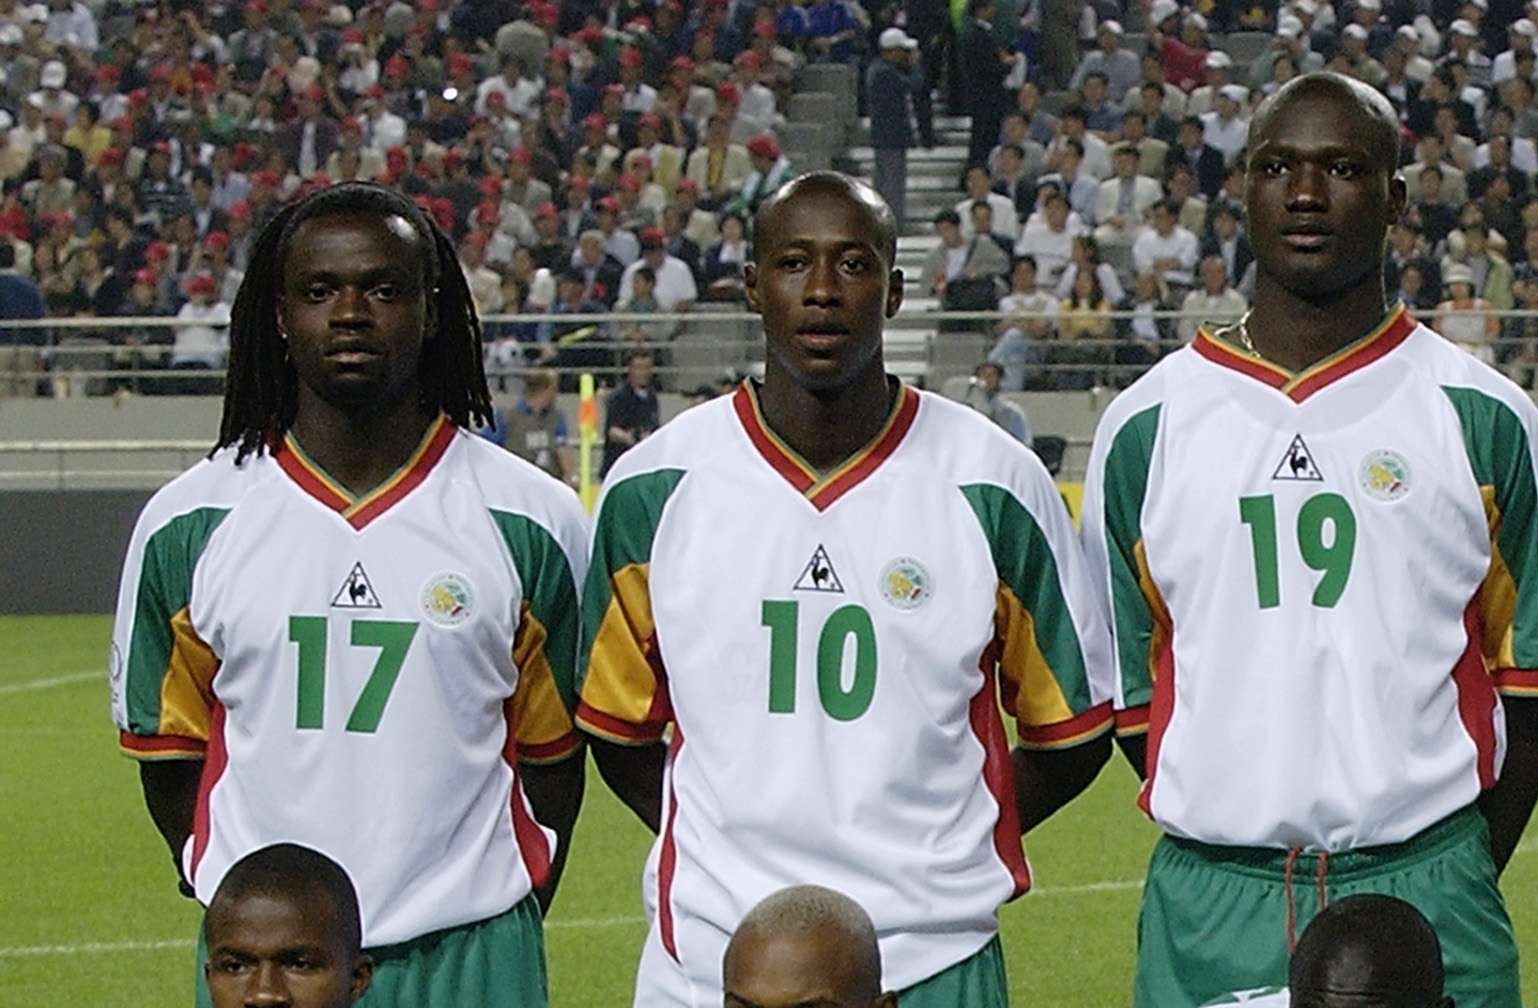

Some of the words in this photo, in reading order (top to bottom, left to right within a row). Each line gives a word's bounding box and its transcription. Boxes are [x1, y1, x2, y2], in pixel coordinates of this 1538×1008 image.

[1238, 492, 1357, 609] 19
[287, 615, 418, 733] 17
[761, 600, 877, 721] 10
